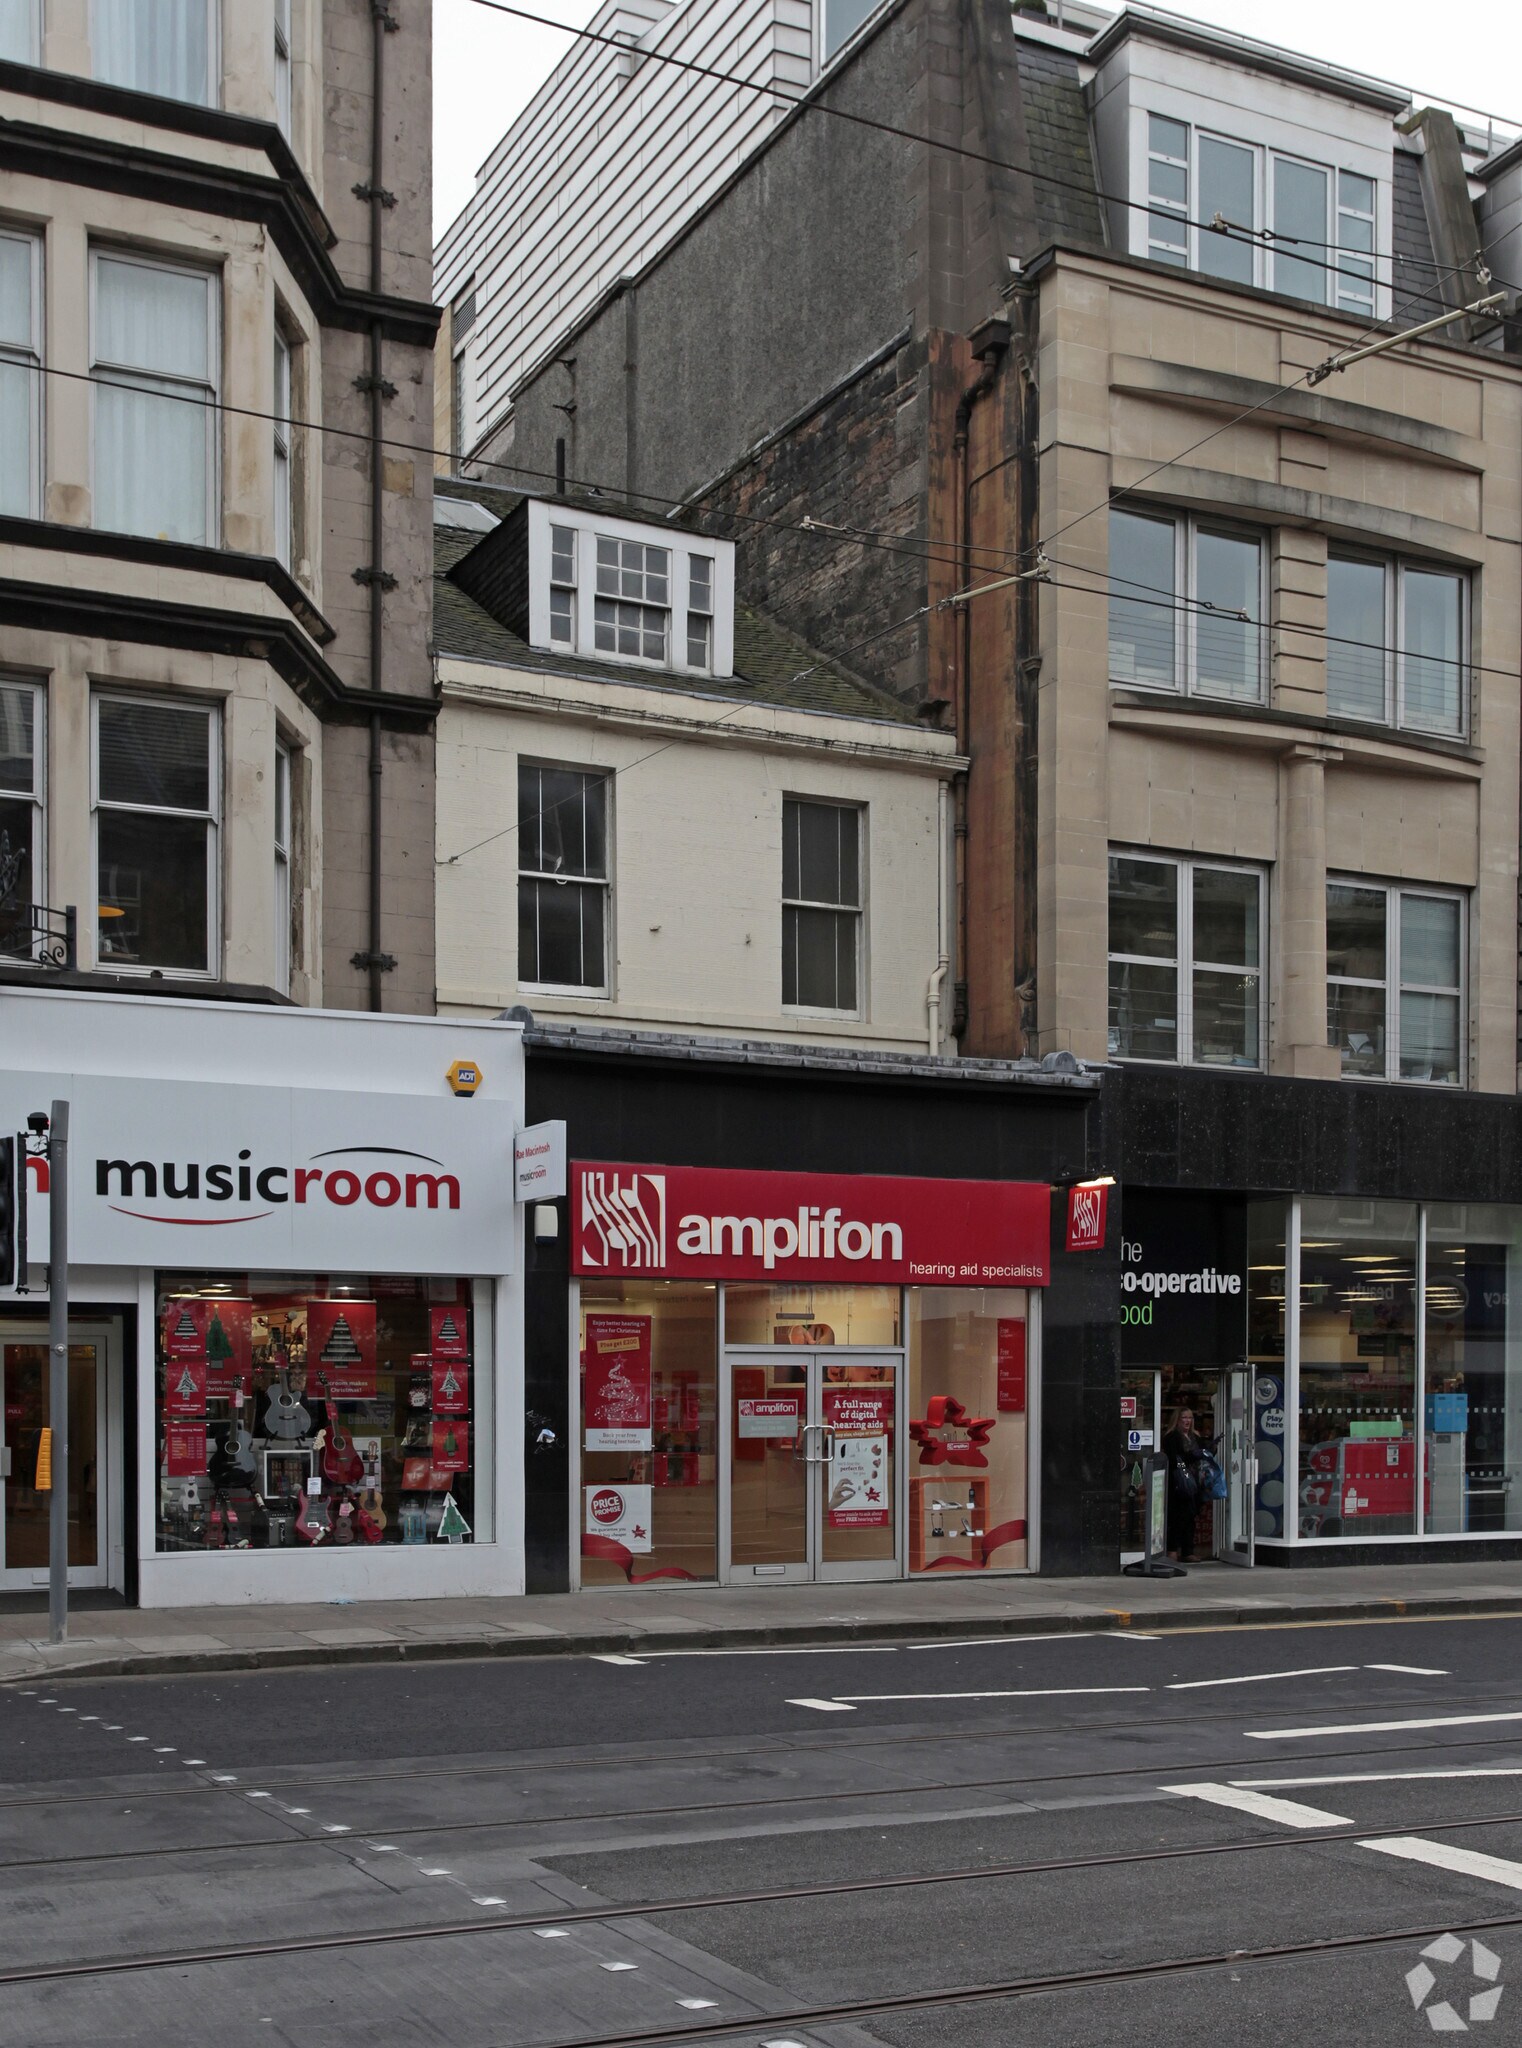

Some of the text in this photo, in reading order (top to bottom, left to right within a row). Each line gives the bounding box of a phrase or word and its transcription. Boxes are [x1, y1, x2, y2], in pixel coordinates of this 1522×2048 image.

[459, 1072, 475, 1081] ADT
[515, 1142, 551, 1160] Rae Macintosh
[96, 1149, 461, 1210] musicroom
[519, 1169, 547, 1182] musicroom
[676, 1206, 903, 1269] amplifon
[1121, 1236, 1142, 1262] he
[909, 1261, 1043, 1279] hearing aid specialists
[1121, 1300, 1153, 1325] ood
[621, 1320, 640, 1328] hearing
[755, 1403, 794, 1414] amplifon
[834, 1399, 883, 1411] A full range
[840, 1409, 877, 1421] of digital
[1266, 1415, 1283, 1423] Play
[833, 1420, 884, 1430] hearing aids
[593, 1496, 620, 1509] PRICE
[594, 1505, 622, 1516] PROMISE
